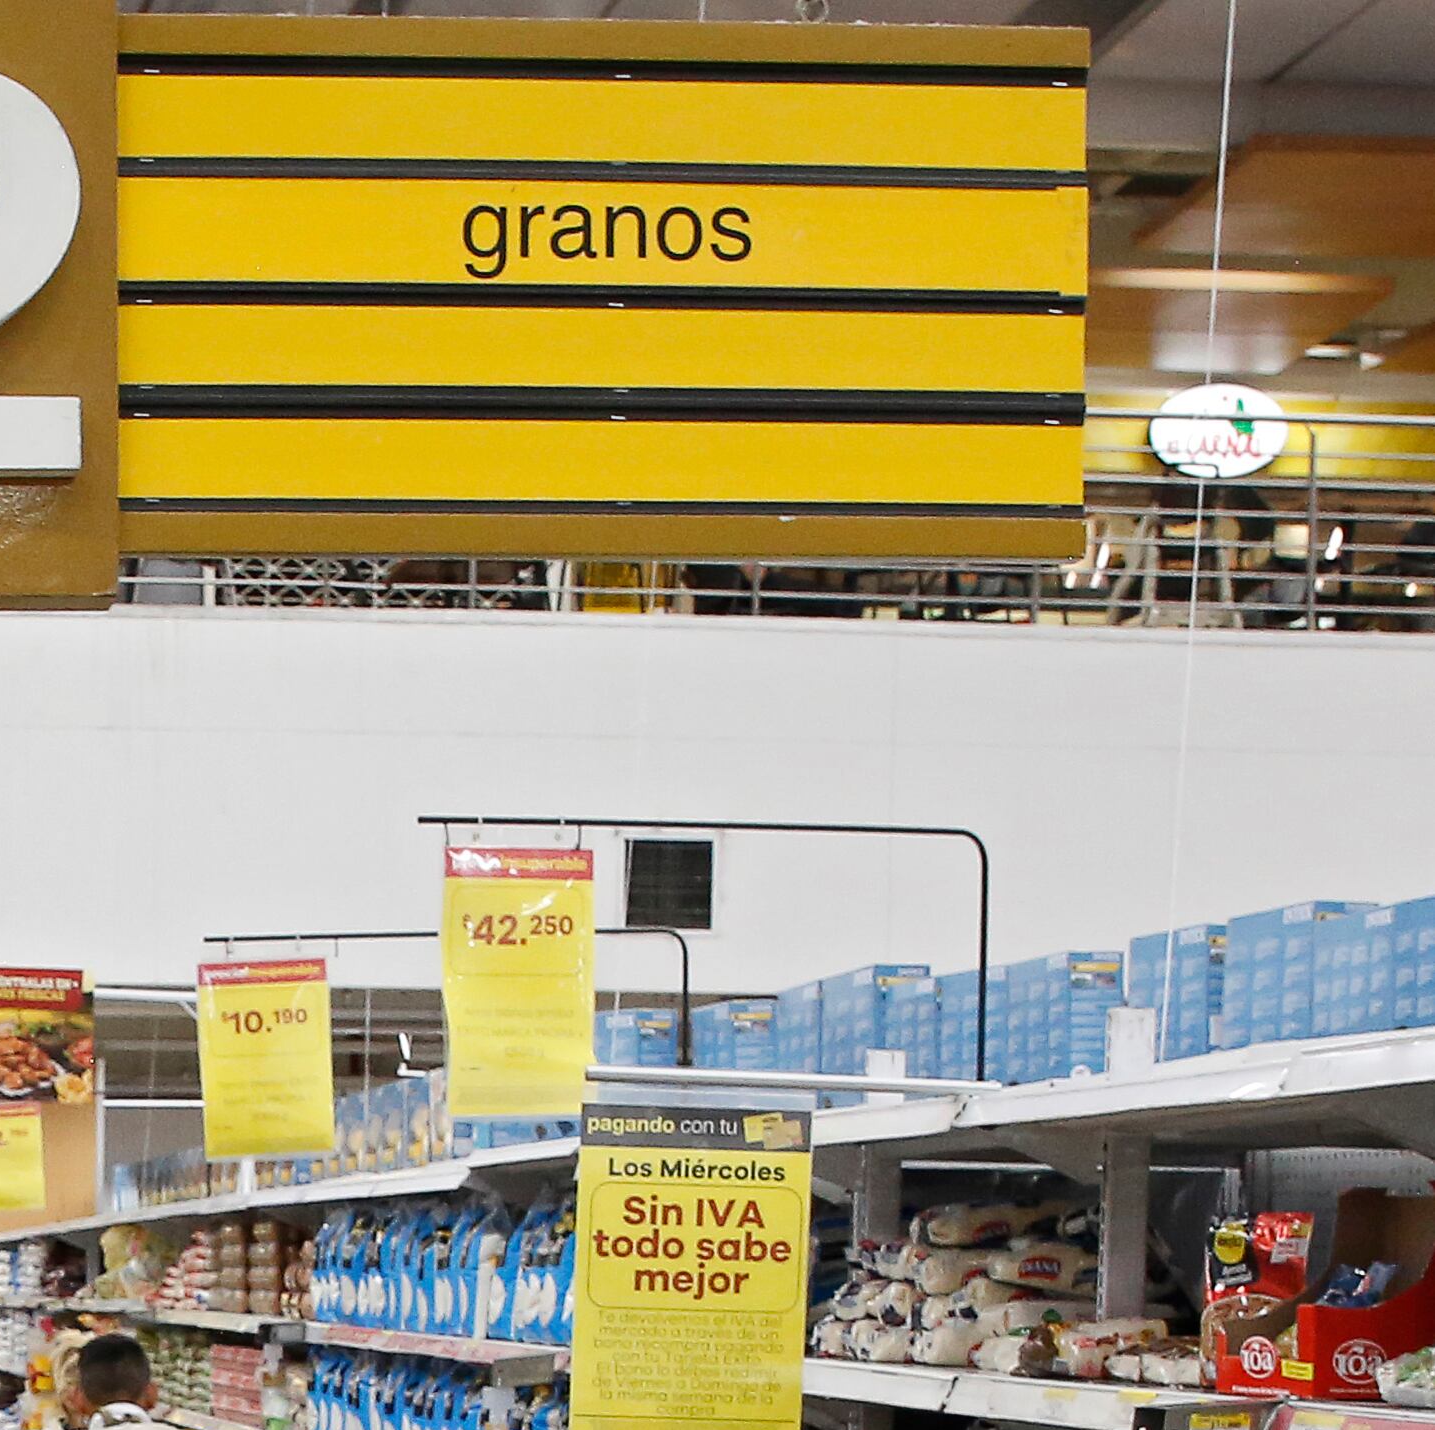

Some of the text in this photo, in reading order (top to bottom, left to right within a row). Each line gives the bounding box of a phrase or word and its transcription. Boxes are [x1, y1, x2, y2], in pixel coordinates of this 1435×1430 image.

[461, 195, 754, 279] granos
[463, 914, 574, 946] $42.250
[221, 1009, 308, 1034] $10.190
[588, 1115, 738, 1136] pagando con tu
[609, 1157, 786, 1182] Los Miércoles
[623, 1195, 765, 1229] Sin IVA
[593, 1229, 792, 1262] todo sabe
[634, 1264, 750, 1300] mejor
